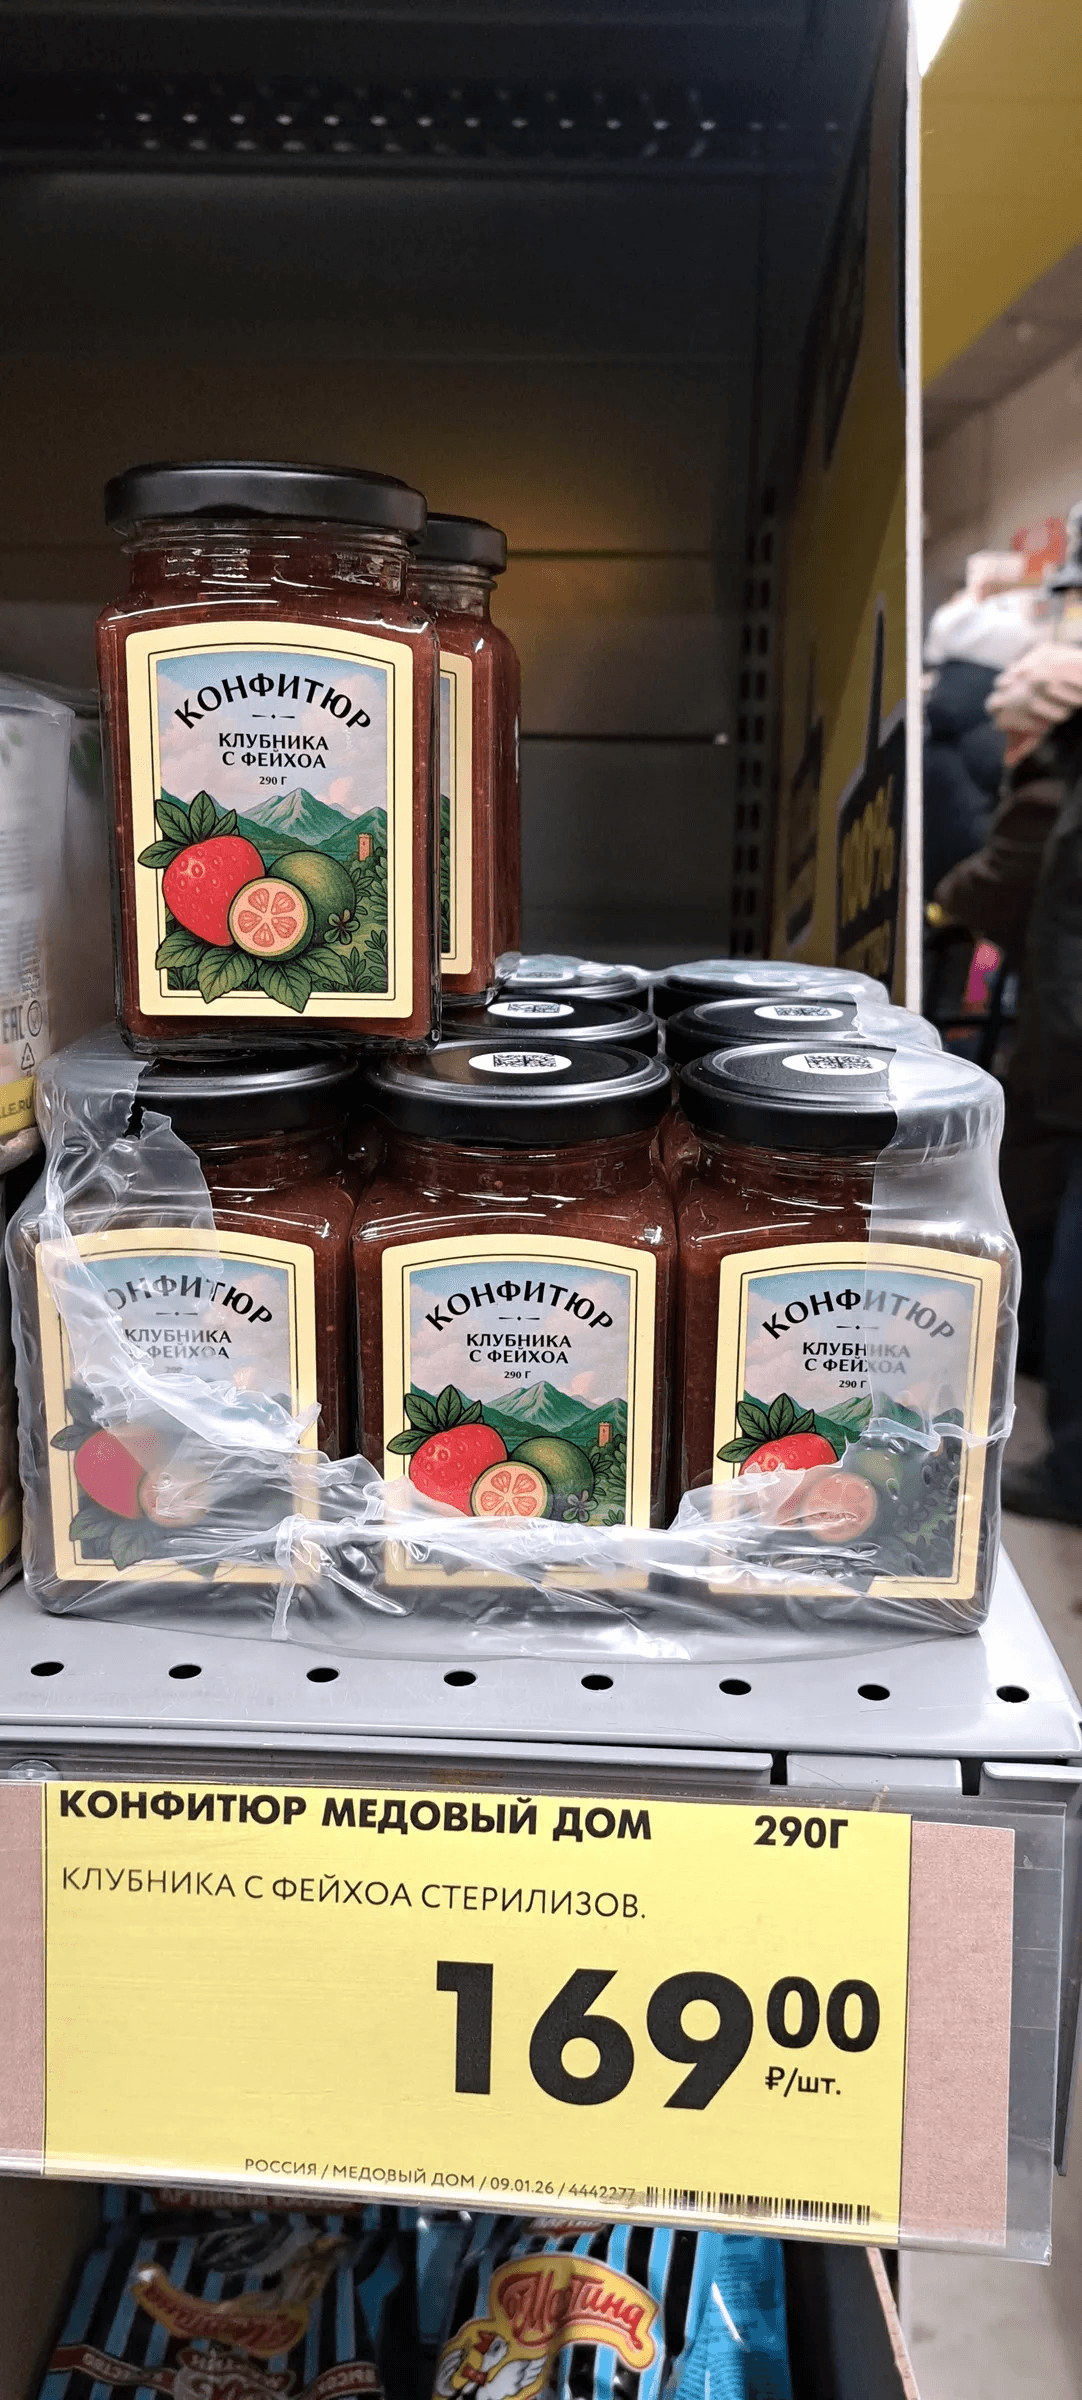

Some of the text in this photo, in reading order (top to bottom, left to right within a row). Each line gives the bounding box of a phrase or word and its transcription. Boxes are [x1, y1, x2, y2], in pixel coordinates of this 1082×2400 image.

[174, 672, 371, 729] КОНФИТЮР
[219, 733, 329, 750] КЛУБНИКА
[222, 749, 326, 768] С ФЕЙХОА
[259, 776, 287, 785] 290 Г
[104, 1275, 273, 1323] ОНФИТЮР
[425, 1280, 613, 1331] КОНФИТЮР
[762, 1289, 955, 1339] КОНФИТЮР
[124, 1328, 232, 1343] КЛУБНИКА
[466, 1333, 572, 1348] КЛУБНИКА
[149, 1342, 230, 1359] ФЕЙХОА
[469, 1347, 569, 1364] С ФЕЙХОА
[802, 1342, 911, 1358] КЛУБНИКА
[804, 1356, 907, 1374] С ФЕЙХОА
[504, 1371, 531, 1379] 290 Г
[838, 1380, 867, 1388] 290 Г
[60, 1789, 848, 1848] КОНФИТЮР МЕДОВЫЙ ДОМ 290Г
[62, 1867, 646, 1919] КЛУБНИКА С ФЕЙХОА СТЕРИЛИЗОВ.
[436, 1960, 880, 2110] 169 00
[765, 2066, 841, 2097] ₽/шт.
[245, 2158, 317, 2175] РОССИЯ
[333, 2165, 426, 2184] МЕДОВЫЙ
[431, 2172, 475, 2188] ДОМ
[490, 2177, 554, 2194] 09.01.26
[568, 2184, 636, 2201] 4442277
